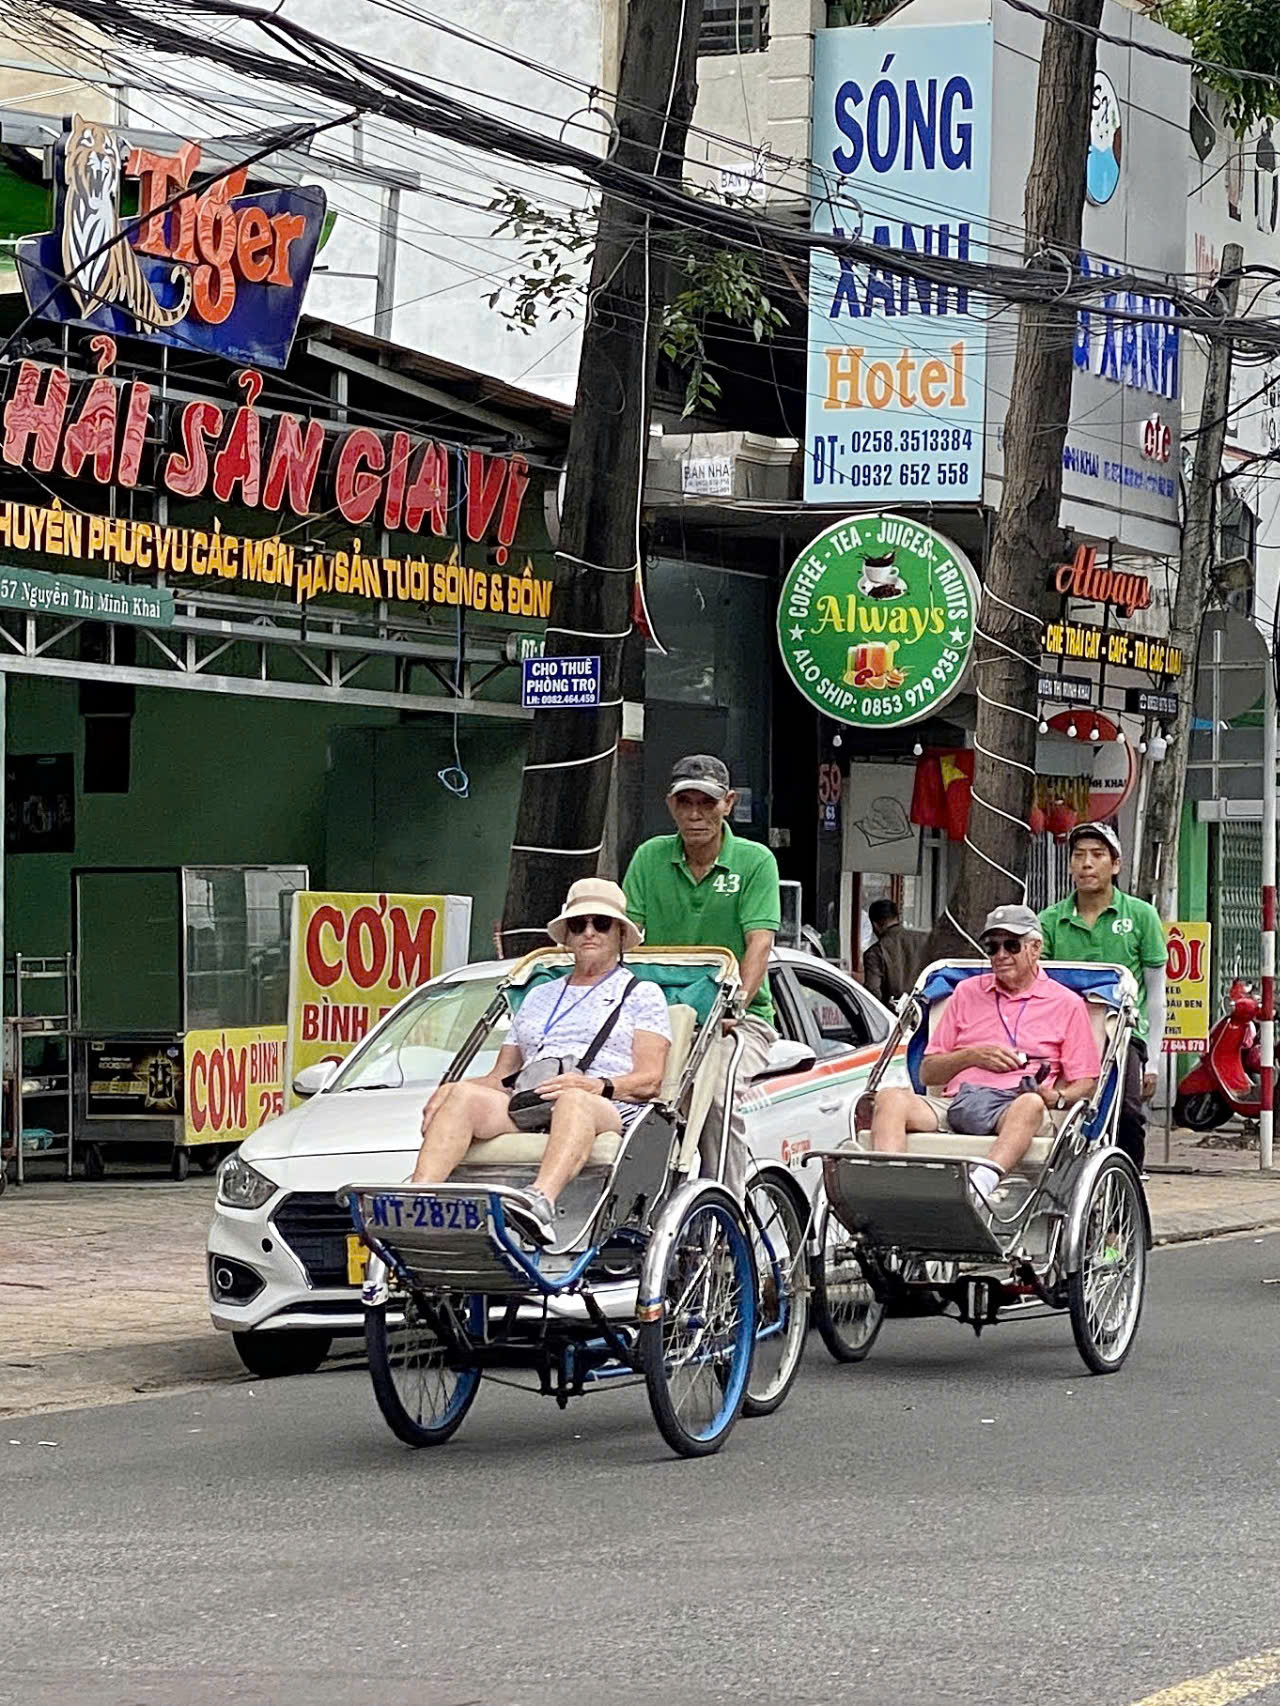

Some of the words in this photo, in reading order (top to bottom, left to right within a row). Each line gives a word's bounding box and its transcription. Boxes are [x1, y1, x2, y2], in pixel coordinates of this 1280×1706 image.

[832, 53, 974, 175] SÓNG
[125, 139, 307, 325] Tiger
[829, 222, 970, 318] XANH
[823, 340, 967, 410] Hotel
[3, 334, 151, 487] HẢI
[164, 369, 325, 516] SẢN
[336, 427, 449, 537] GIA
[466, 450, 530, 566] VỊ
[851, 428, 973, 454] 0258.3513384
[851, 463, 892, 487] 0932
[899, 462, 931, 486] 652
[937, 461, 970, 485] 558
[97, 592, 129, 615] Minh
[132, 597, 161, 618] Khai
[334, 537, 383, 599] SẢN
[489, 573, 504, 612] &
[788, 554, 828, 618] COFFEE
[829, 526, 863, 556] TEA
[934, 559, 969, 621] FRUITS
[1056, 543, 1153, 618] Always
[810, 594, 945, 645] Always
[526, 676, 569, 693] PHÒNG
[571, 678, 596, 693] TRỌ
[532, 662, 558, 676] CHO
[560, 657, 593, 675] THUÊ
[793, 648, 821, 682] ALO
[816, 678, 858, 713] SHIP:
[861, 694, 903, 716] 0853
[904, 677, 935, 707] 979
[931, 647, 960, 682] 935
[712, 873, 741, 893] 43
[305, 893, 437, 990] CƠM
[1111, 917, 1134, 935] 69
[1166, 926, 1202, 981] ÔI
[301, 996, 369, 1043] BÌNH
[189, 1032, 248, 1134] CƠM
[250, 1034, 279, 1084] BÌNH
